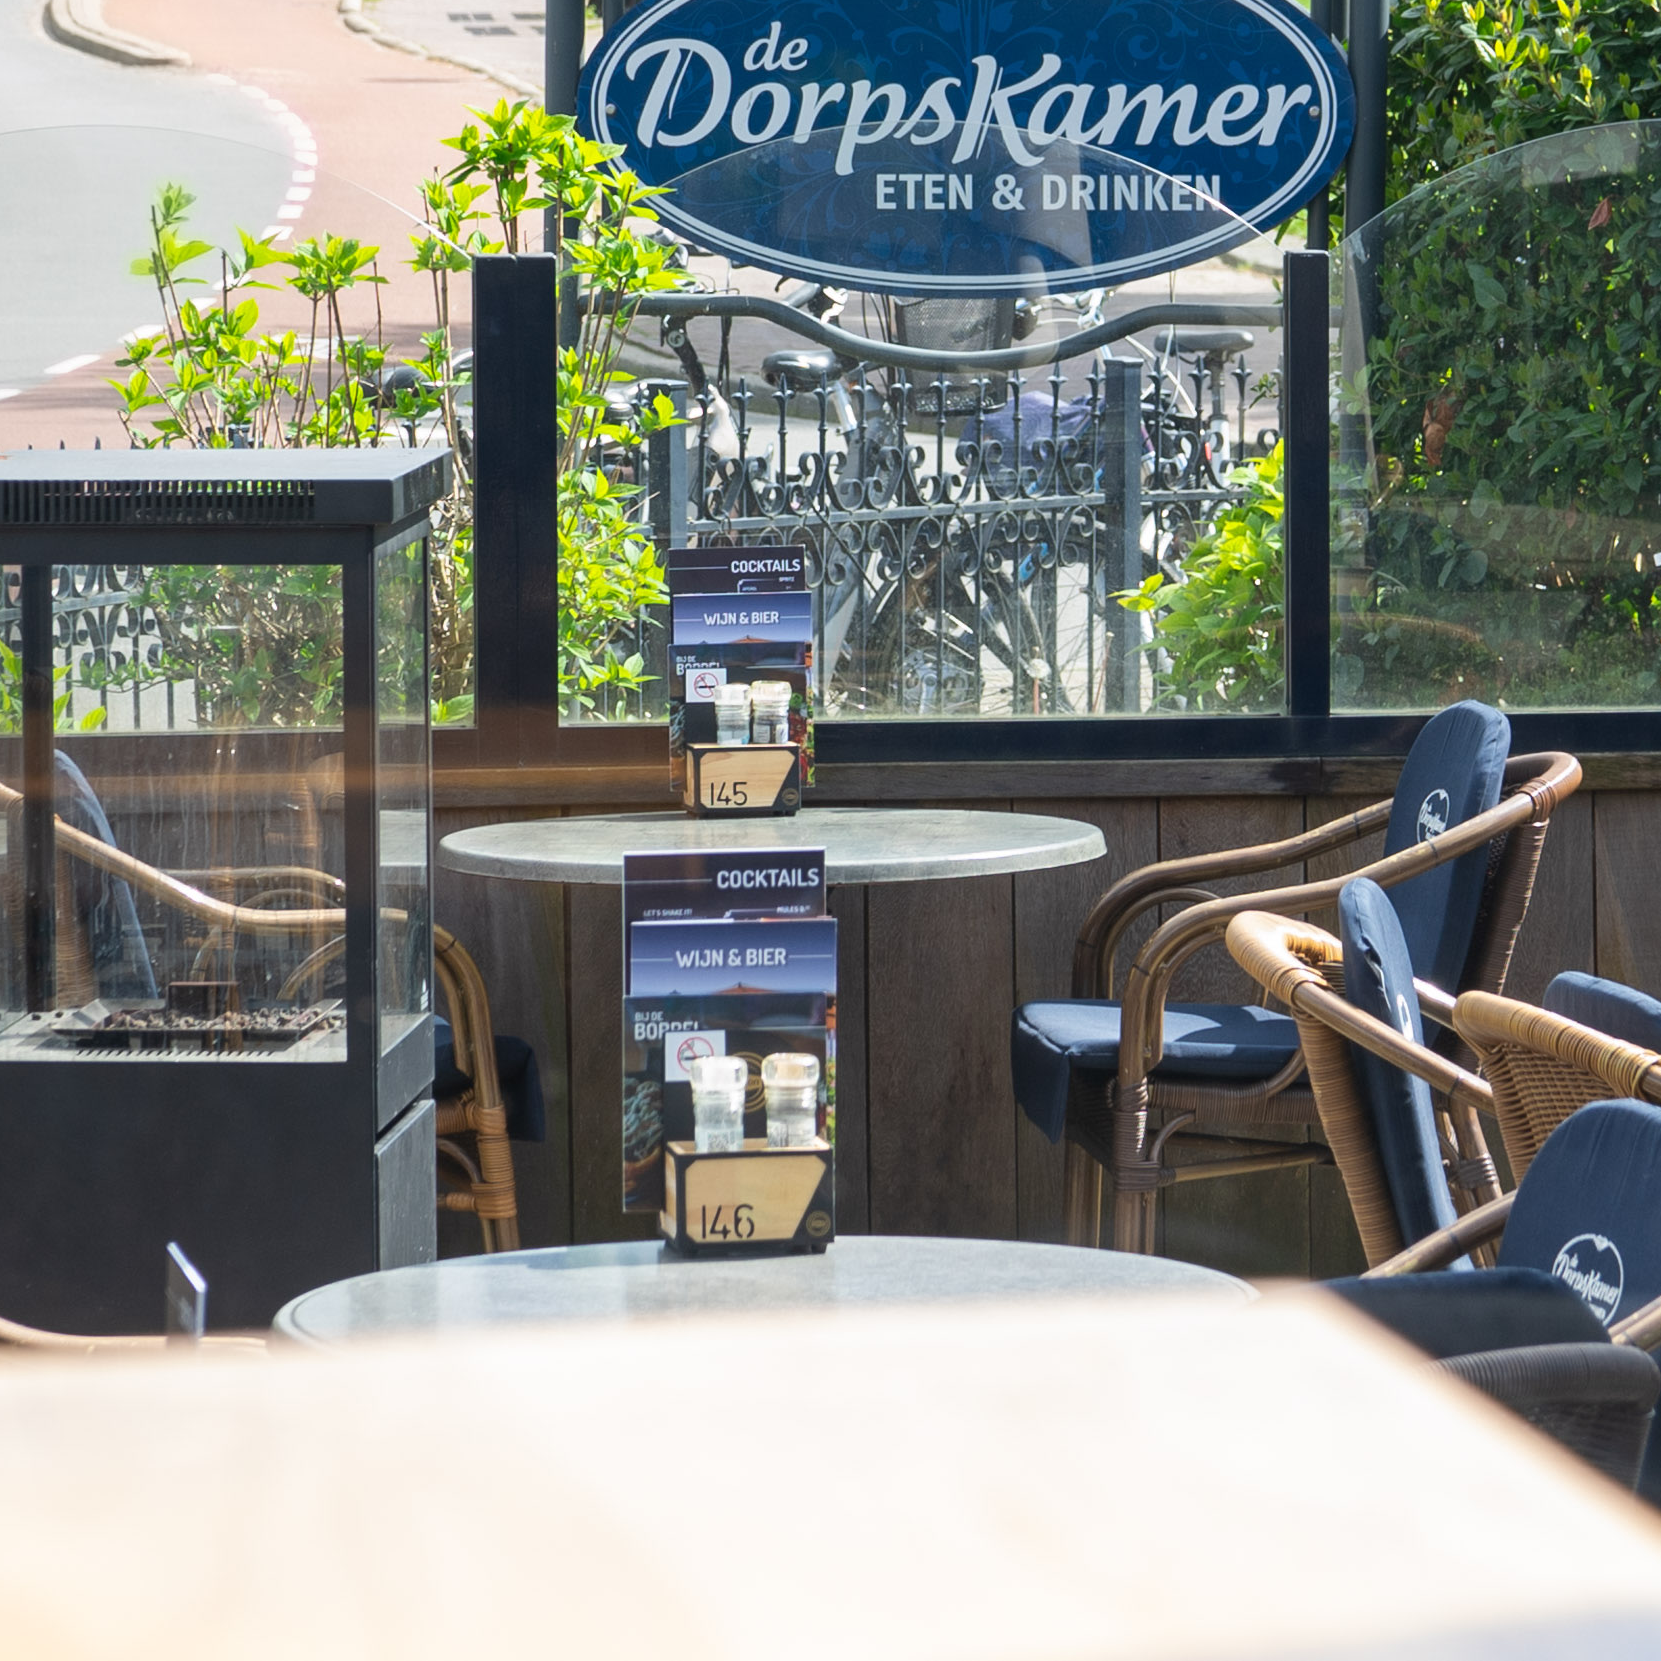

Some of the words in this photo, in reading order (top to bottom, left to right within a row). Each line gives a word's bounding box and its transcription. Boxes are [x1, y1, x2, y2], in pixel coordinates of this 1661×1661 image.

[743, 21, 809, 73] de
[625, 37, 1313, 177] DorpsKamer
[876, 174, 974, 211] ETEN
[991, 174, 1026, 211] &
[1041, 174, 1222, 213] DRINKEN
[731, 558, 801, 574] COCKTAILS
[703, 612, 737, 626] WIJN
[739, 611, 749, 625] &
[751, 611, 780, 625] BIER
[710, 782, 748, 806] 145
[717, 868, 820, 889] COCKTAILS
[676, 949, 724, 968] WIJN
[728, 948, 742, 966] &
[746, 947, 787, 966] BIER
[701, 1203, 755, 1240] 146
